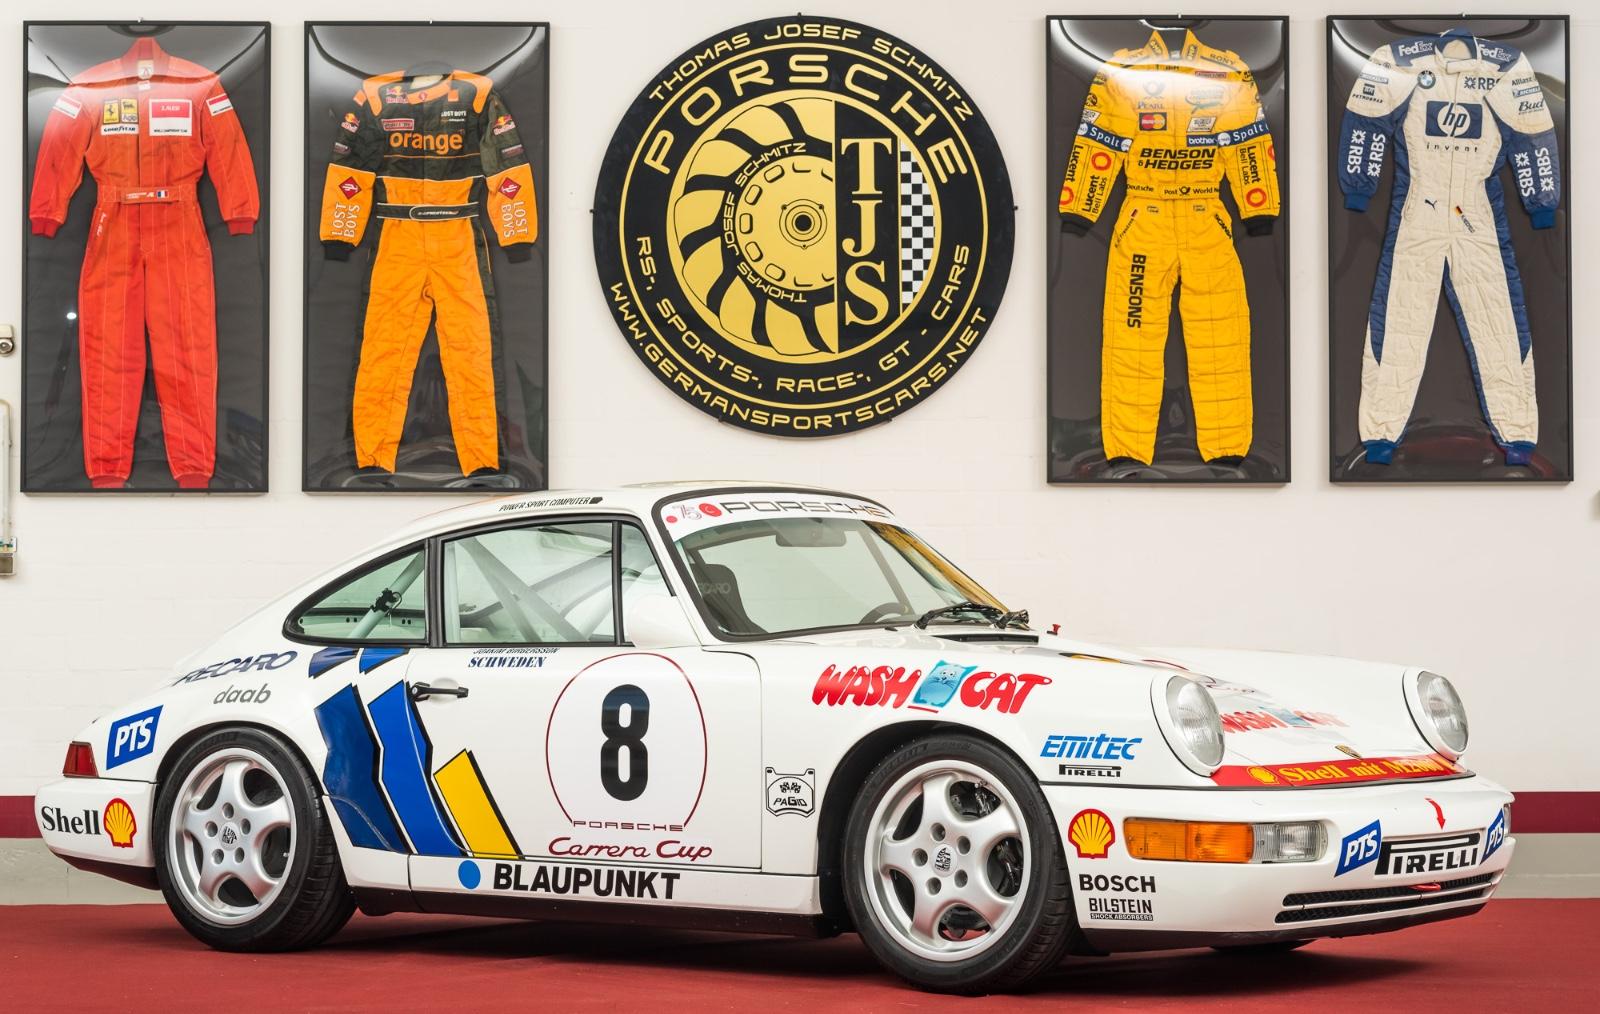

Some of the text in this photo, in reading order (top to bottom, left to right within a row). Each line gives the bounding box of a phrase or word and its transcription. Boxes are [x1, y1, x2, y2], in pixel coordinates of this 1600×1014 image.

[649, 23, 974, 122] THOMAS JOSEF SCHMITZ
[643, 54, 969, 185] PORSCHE
[1442, 102, 1468, 137] hp
[1518, 100, 1544, 112] Bud
[389, 131, 463, 155] orange
[1089, 126, 1120, 148] Spalt
[1188, 136, 1214, 145] brother
[1233, 122, 1264, 142] Spalt
[1426, 142, 1478, 153] invent
[1065, 144, 1084, 183] Lucent
[1140, 148, 1216, 159] BENSON
[1144, 159, 1214, 170] HEDGES
[1247, 145, 1261, 184] Lucent
[1346, 144, 1365, 174] RBS
[1369, 133, 1387, 165] RBS
[1535, 147, 1555, 177] RBS
[1164, 188, 1178, 196] Post
[1192, 186, 1213, 195] World
[1241, 165, 1250, 186] Labs
[1517, 166, 1536, 197] RBS
[1081, 174, 1100, 213] Lucent
[331, 202, 347, 237] LOST
[343, 203, 361, 238] BOYS
[500, 203, 515, 239] BOYS
[512, 201, 528, 235] LOST
[723, 142, 807, 303] THOMAS JOSEF SCHMITZ
[1127, 253, 1147, 329] BENSONS
[879, 341, 913, 372] GT
[932, 244, 970, 323] CARS
[610, 281, 988, 430] WWW.GERMANSPORTSCARS.NET
[498, 496, 591, 512] POWER SPORT COMPUTER
[719, 501, 889, 518] PORSCHE
[171, 650, 298, 687] RECARO
[467, 656, 548, 668] SCHWEDEN
[212, 683, 272, 705] daab
[811, 663, 1053, 714] WASH CAT
[113, 716, 154, 758] PTS
[600, 683, 651, 802] 8
[1058, 763, 1122, 778] PIRELLI
[1278, 764, 1350, 782] Shell
[1348, 760, 1387, 777] mit
[40, 804, 103, 836] Shell
[572, 820, 685, 832] PORSCHE
[548, 836, 713, 862] Carrera Cup
[1343, 829, 1378, 868] PTS
[1486, 817, 1504, 855] PTS
[1374, 832, 1481, 876] PIRELLI
[493, 863, 681, 900] BLAUPUNKT
[1078, 873, 1156, 893] BOSCH
[1088, 897, 1153, 914] BILSTEIN
[1090, 912, 1154, 921] SHOCK ABSORBERS
